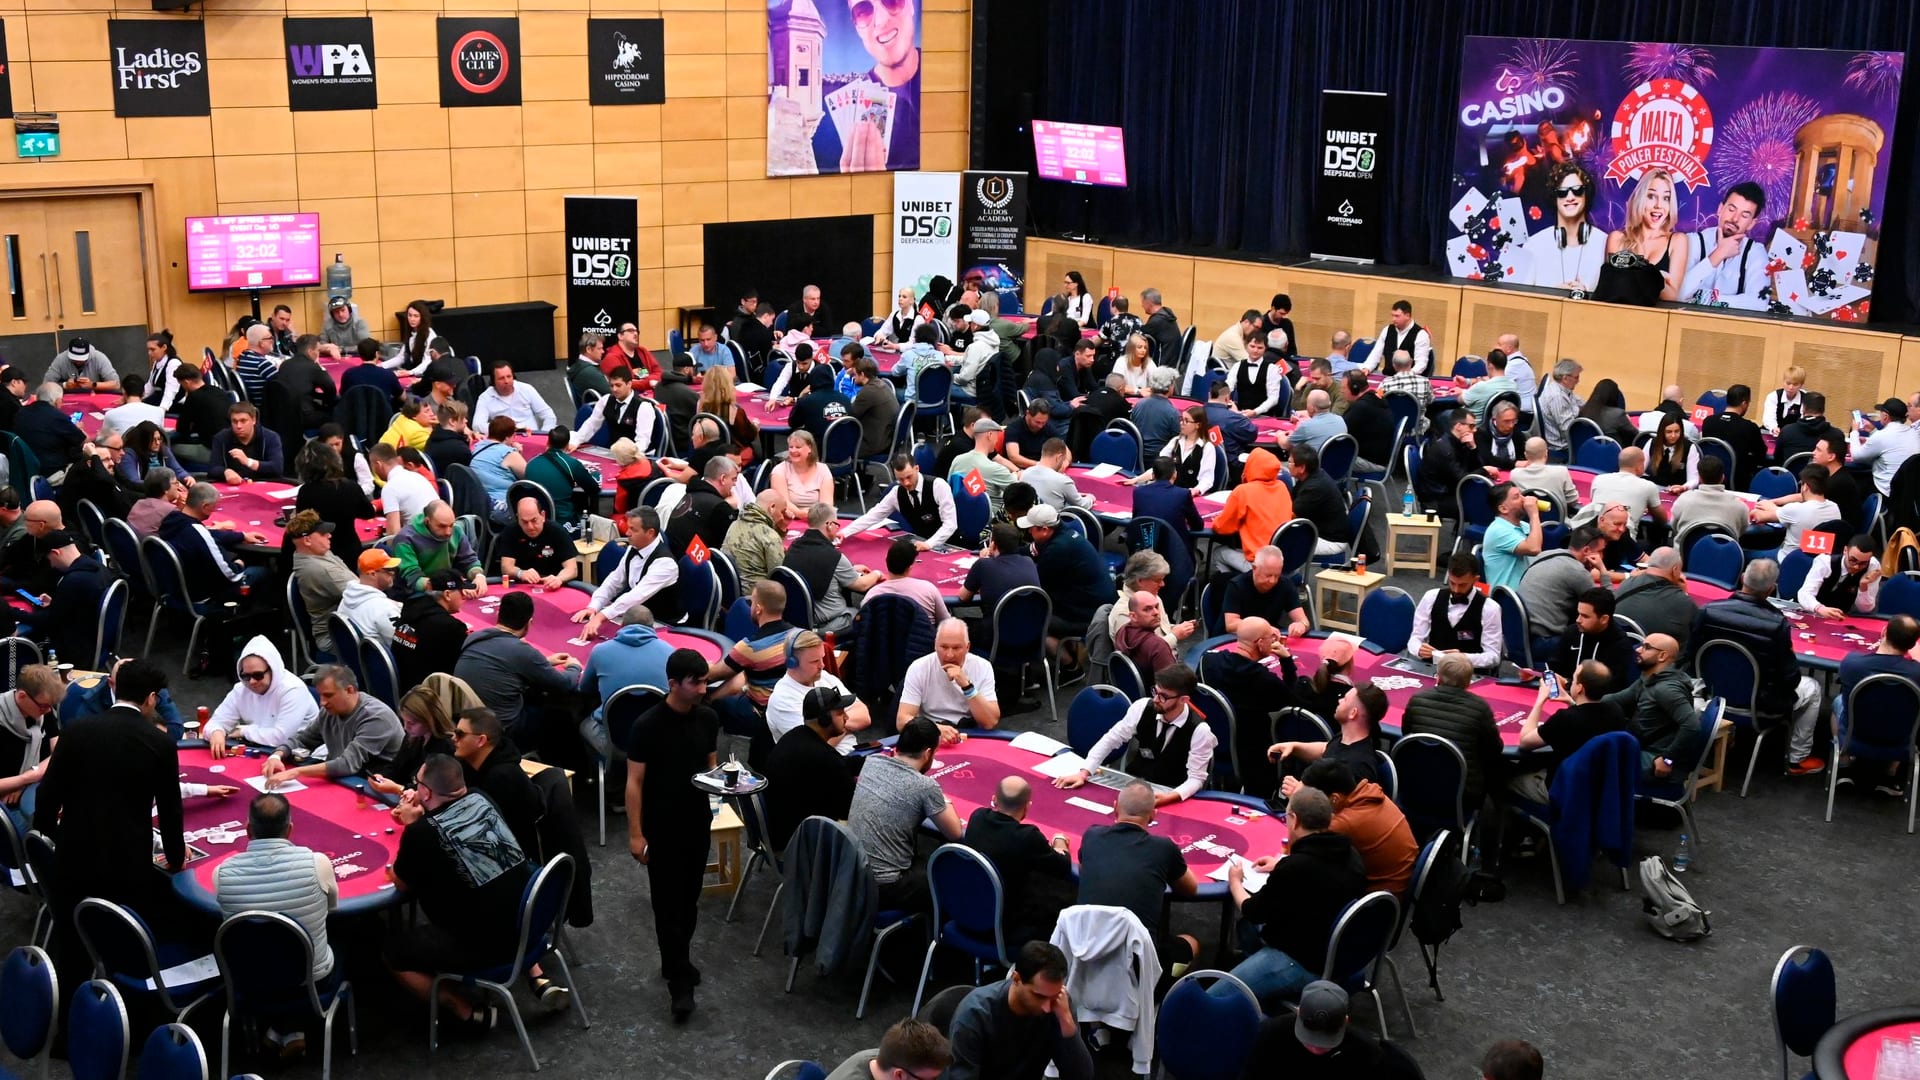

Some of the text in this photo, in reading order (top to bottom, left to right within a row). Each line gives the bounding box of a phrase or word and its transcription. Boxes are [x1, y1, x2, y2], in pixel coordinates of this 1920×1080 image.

[116, 47, 201, 73] Ladies
[290, 44, 372, 76] WPA
[461, 51, 500, 60] LADIES
[466, 60, 494, 70] CLUB
[118, 68, 192, 89] First
[1462, 87, 1565, 127] CASINO
[1640, 110, 1683, 147] MALTA
[1326, 130, 1378, 146] UNIBET
[1618, 147, 1699, 178] POKER FESTIVAL
[1324, 170, 1373, 180] DEEPSTACK OPEN
[902, 201, 952, 212] UNIBET
[236, 244, 278, 258] 32:02
[572, 237, 631, 251] UNIBET
[1695, 408, 1708, 420] 03
[967, 476, 980, 494] 14
[1806, 535, 1826, 550] 11
[690, 544, 704, 563] 18
